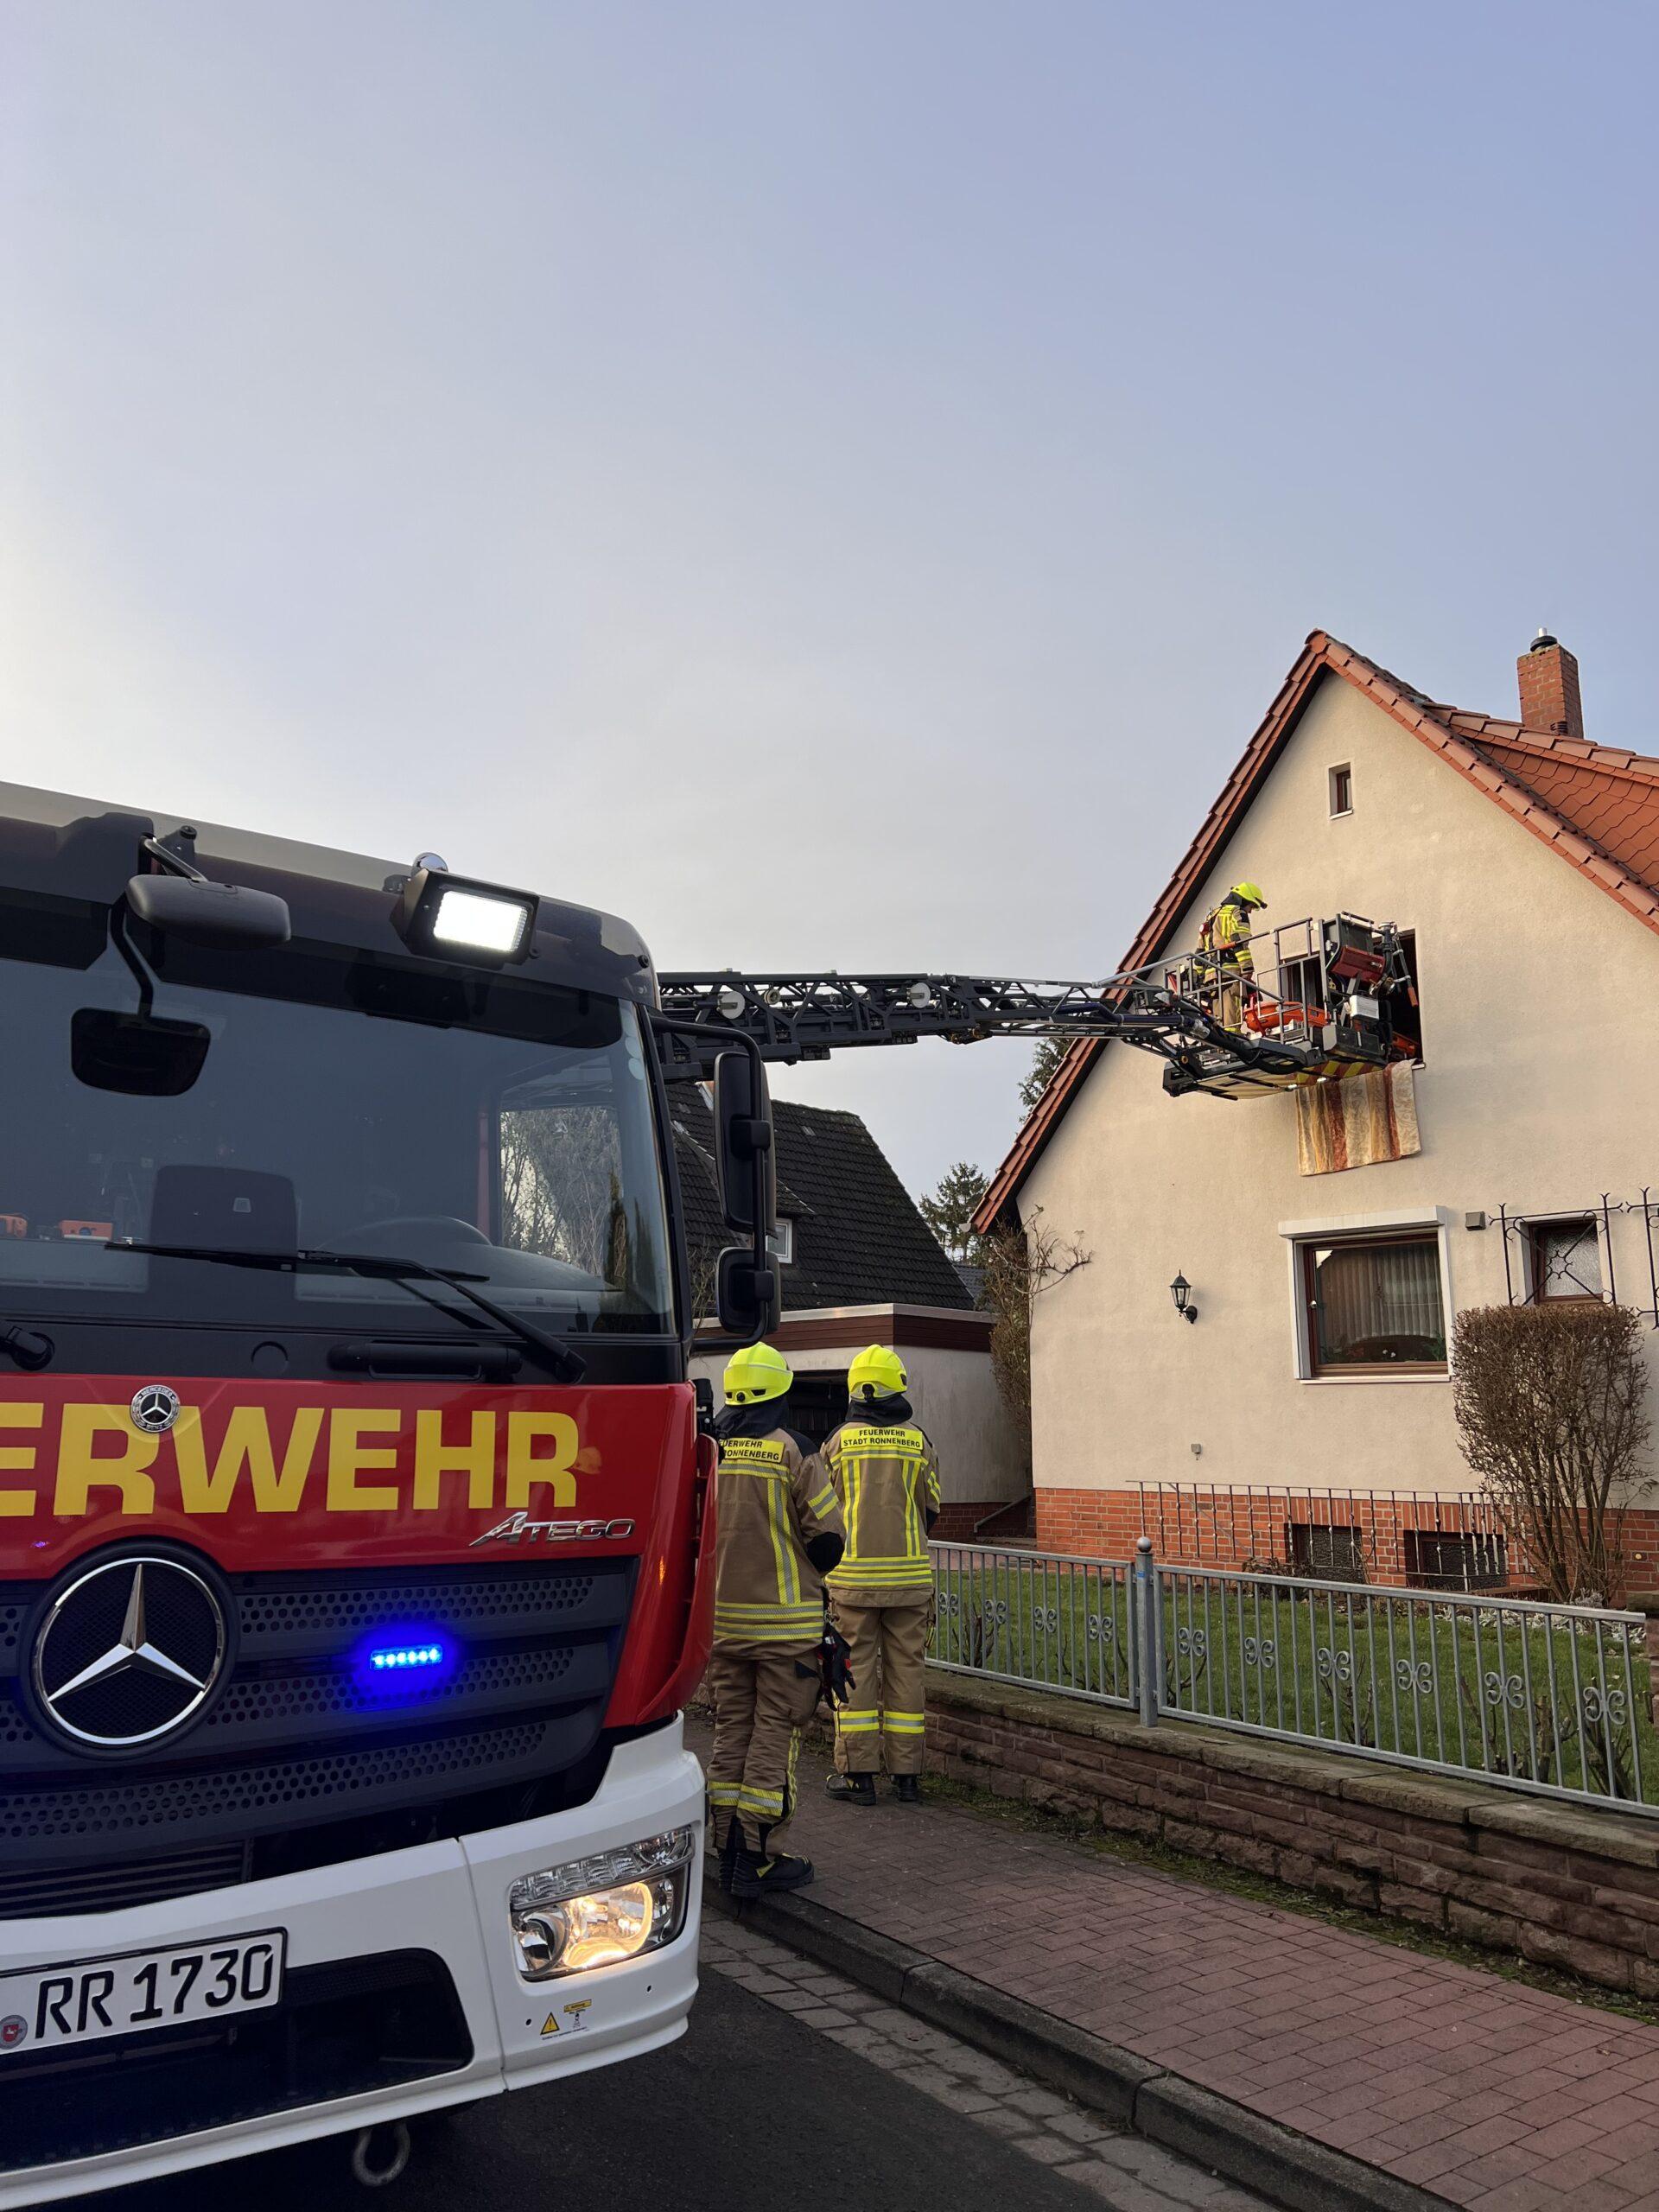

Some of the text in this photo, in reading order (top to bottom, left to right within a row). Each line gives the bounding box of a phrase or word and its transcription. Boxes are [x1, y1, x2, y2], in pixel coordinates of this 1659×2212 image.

[843, 1437, 920, 1448] STADT RONNENBERG
[859, 1428, 906, 1437] FEUERWEHR
[0, 1402, 579, 1516] ERWEHR
[724, 1449, 779, 1460] ONNENBERG
[468, 1511, 636, 1547] ATEGO
[35, 1943, 274, 2039] RR 1730
